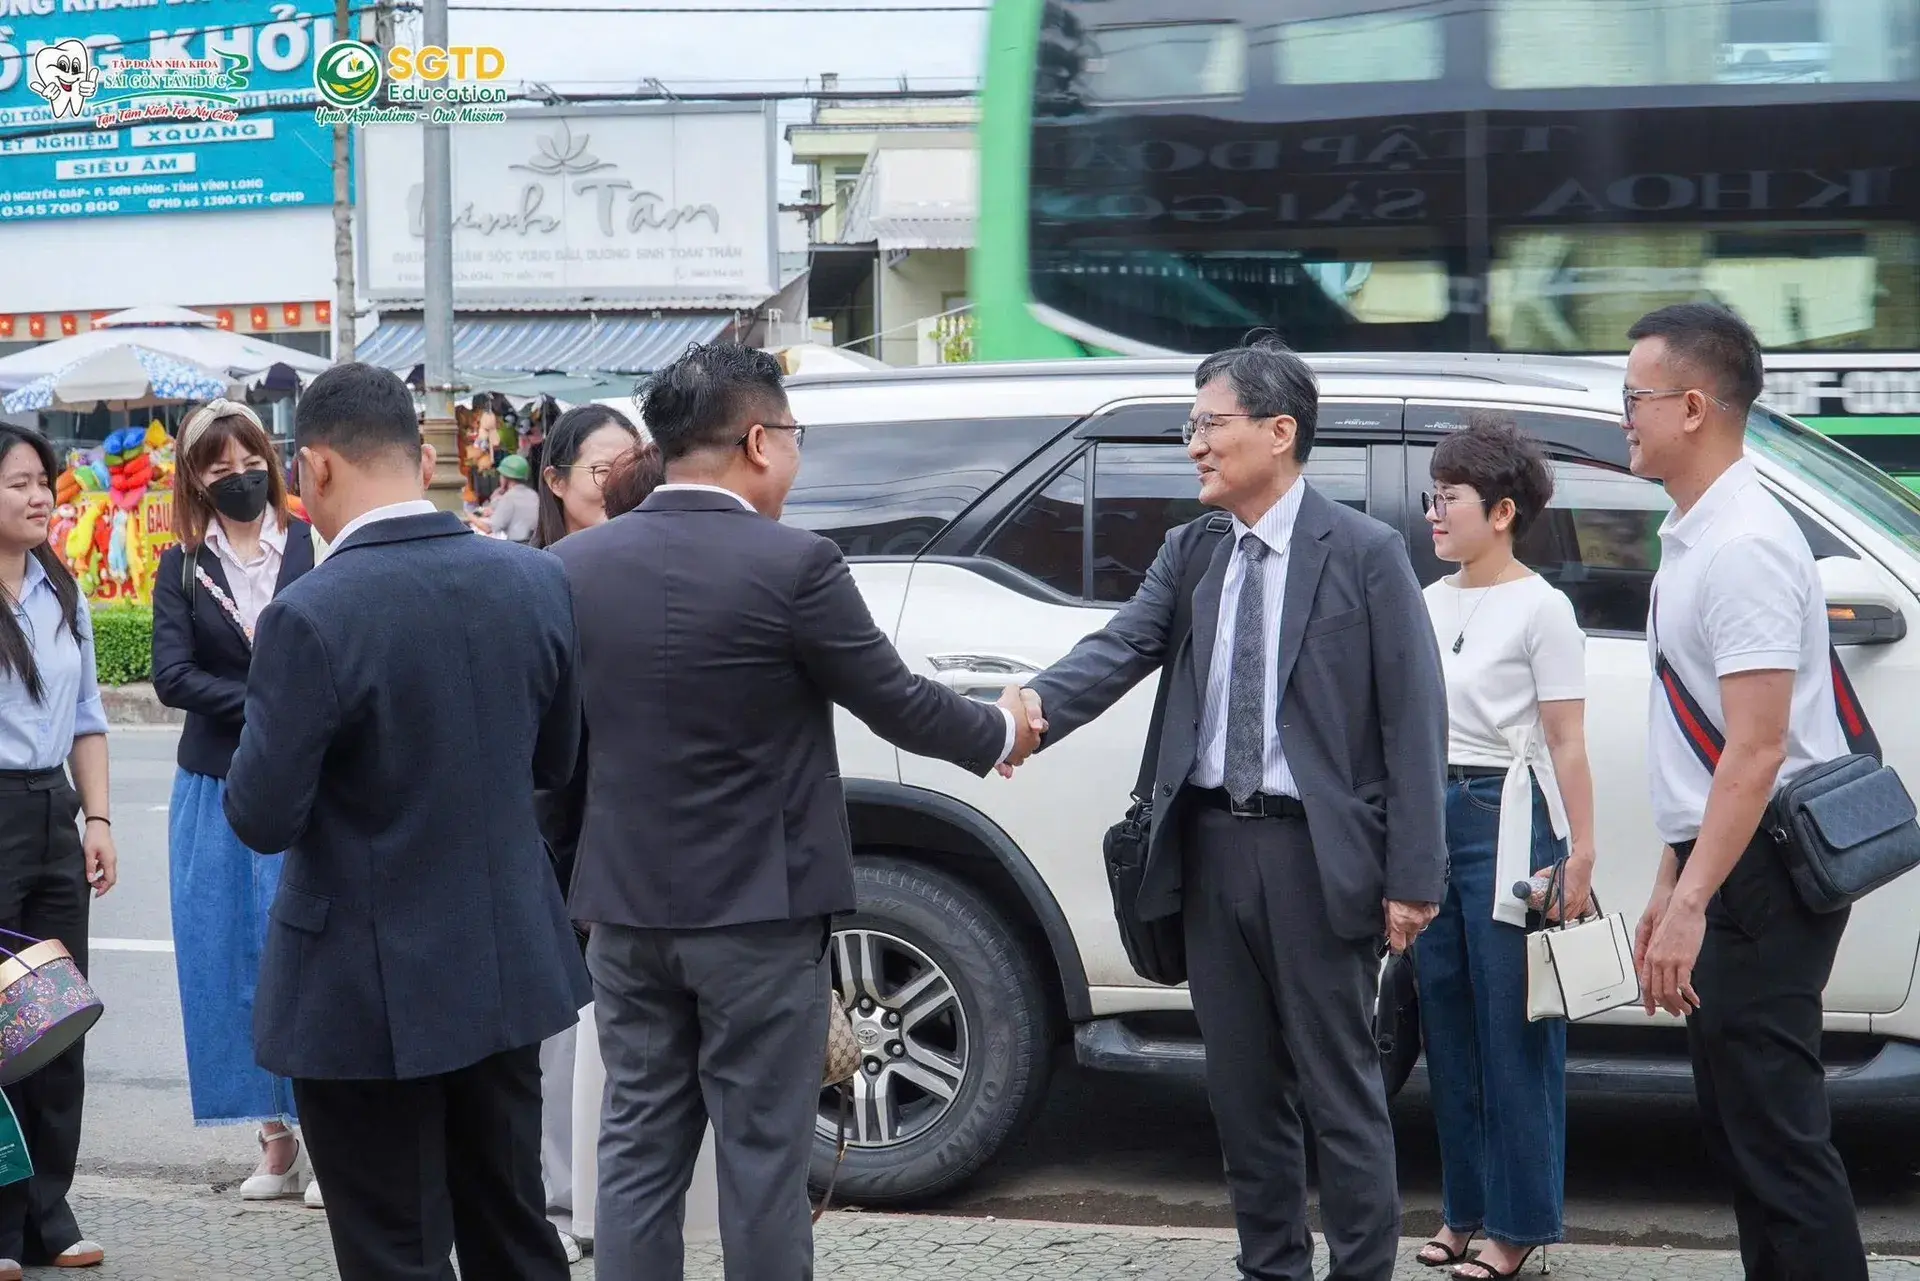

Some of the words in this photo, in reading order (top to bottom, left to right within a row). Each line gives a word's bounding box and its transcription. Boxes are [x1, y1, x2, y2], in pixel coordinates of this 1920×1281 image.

[0, 0, 54, 17] NG
[149, 4, 333, 80] KHỞI
[36, 131, 112, 149] NGHIỆM
[149, 125, 258, 142] XQUANG
[74, 159, 128, 175] SIÊU
[142, 157, 177, 170] ÂM
[231, 177, 264, 190] LONG
[1, 204, 47, 217] 0345
[49, 202, 82, 214] 700
[84, 200, 120, 213] 800
[572, 178, 719, 237] Tâm
